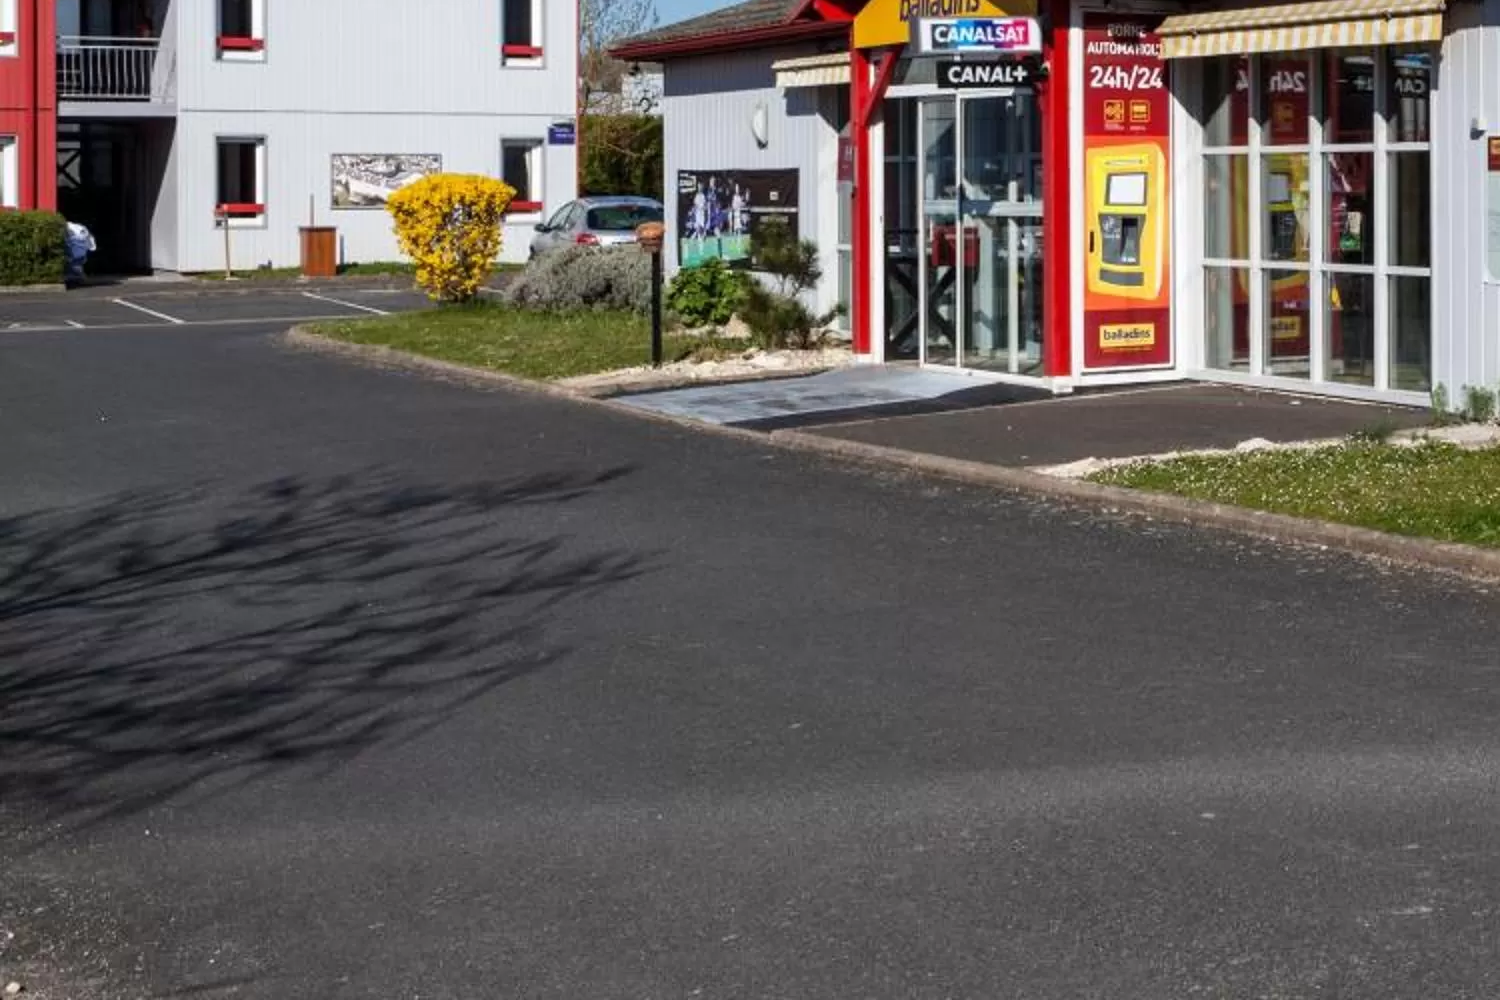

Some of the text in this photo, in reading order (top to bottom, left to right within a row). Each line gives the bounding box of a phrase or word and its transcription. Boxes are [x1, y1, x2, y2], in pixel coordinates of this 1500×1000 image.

[935, 25, 1026, 43] CANALSAT
[948, 65, 1028, 83] CANAL+
[1089, 64, 1163, 91] 24h/24
[1103, 326, 1151, 341] balladins
